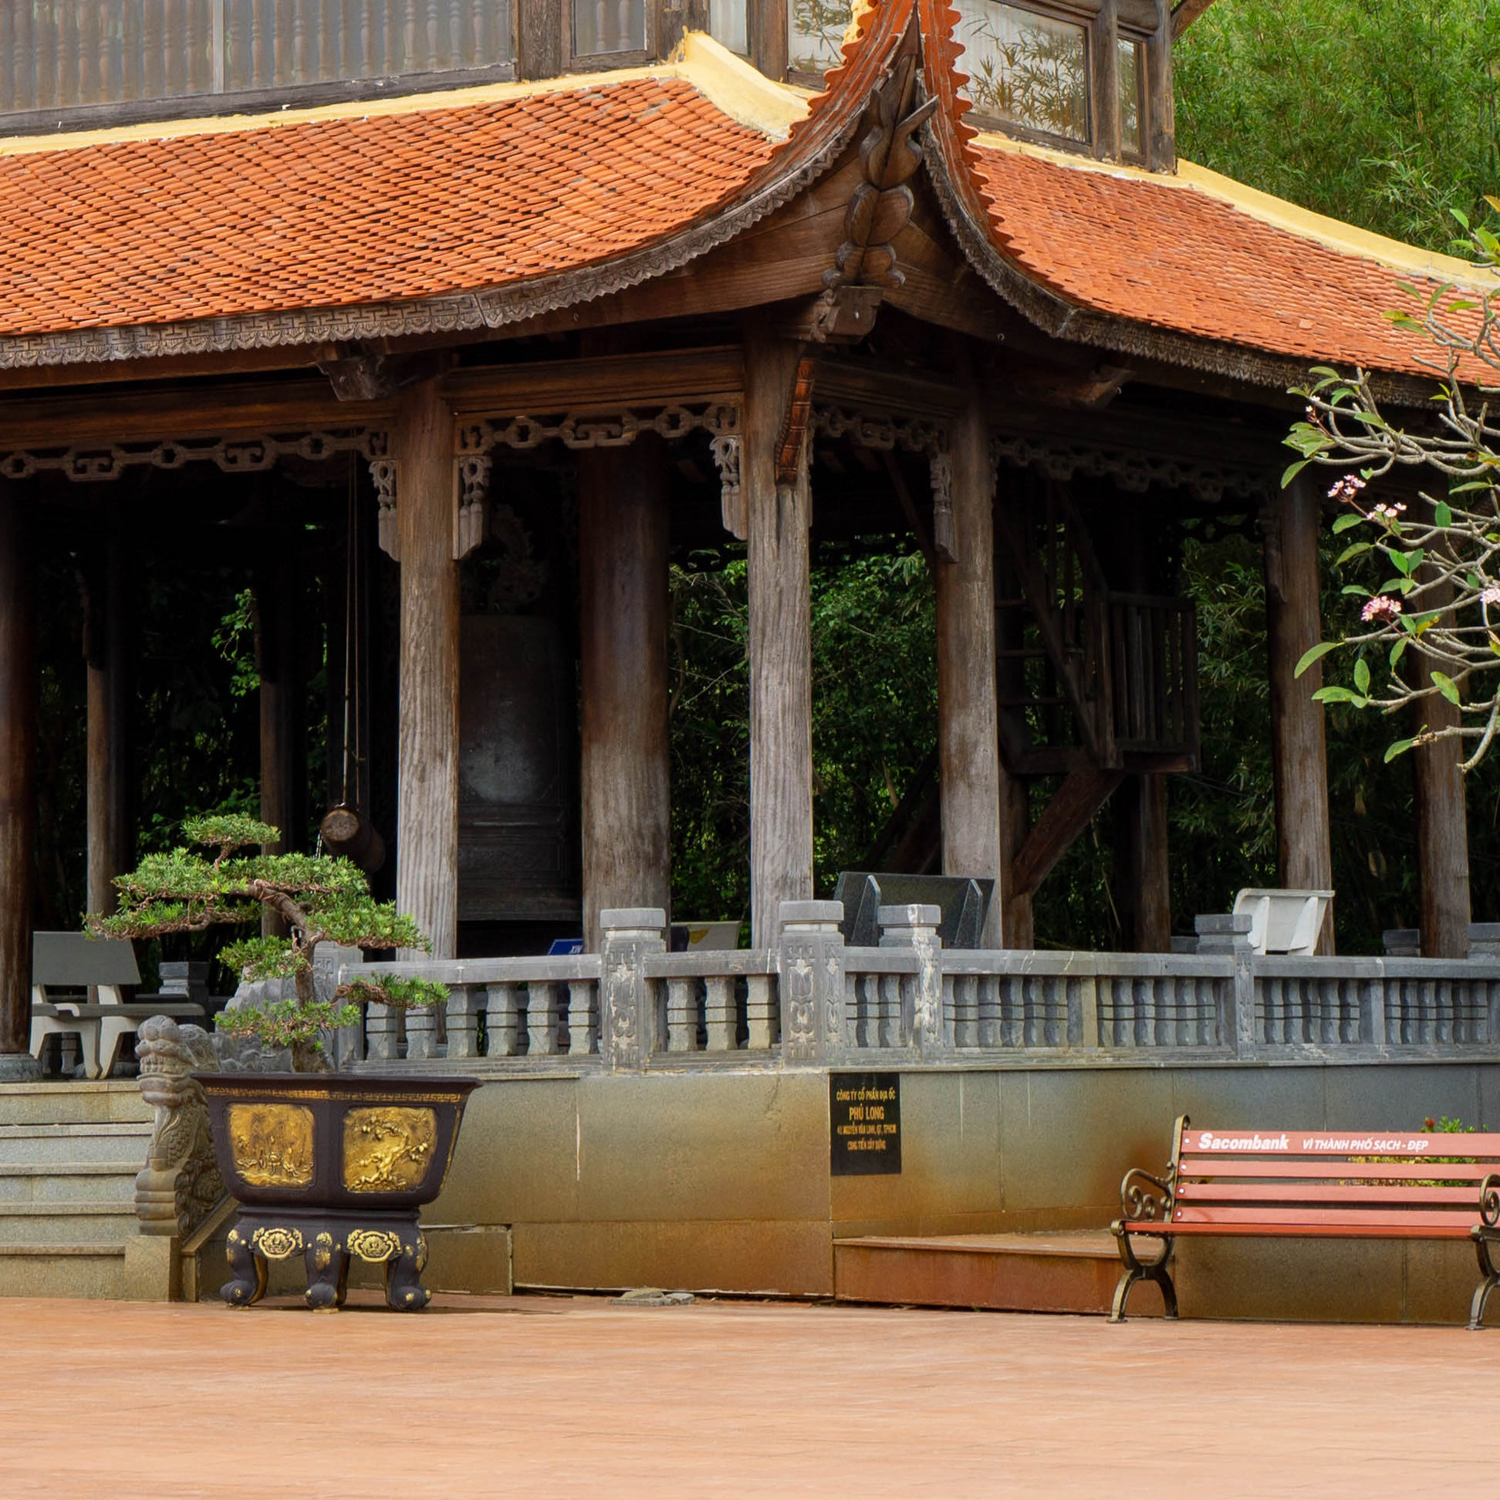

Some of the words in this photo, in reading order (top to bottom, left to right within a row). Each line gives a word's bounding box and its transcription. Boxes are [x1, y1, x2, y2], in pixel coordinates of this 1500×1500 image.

[837, 1089, 850, 1101] CÔNG
[849, 1103, 864, 1121] PHÚ
[866, 1106, 884, 1120] LONG
[1199, 1133, 1289, 1150] Sacombank
[1302, 1138, 1313, 1148] VÌ
[1314, 1137, 1349, 1149] THÀNH
[1350, 1137, 1373, 1150] PHỐ
[1374, 1140, 1400, 1152] SẠCH
[1408, 1141, 1428, 1152] ĐẸP
